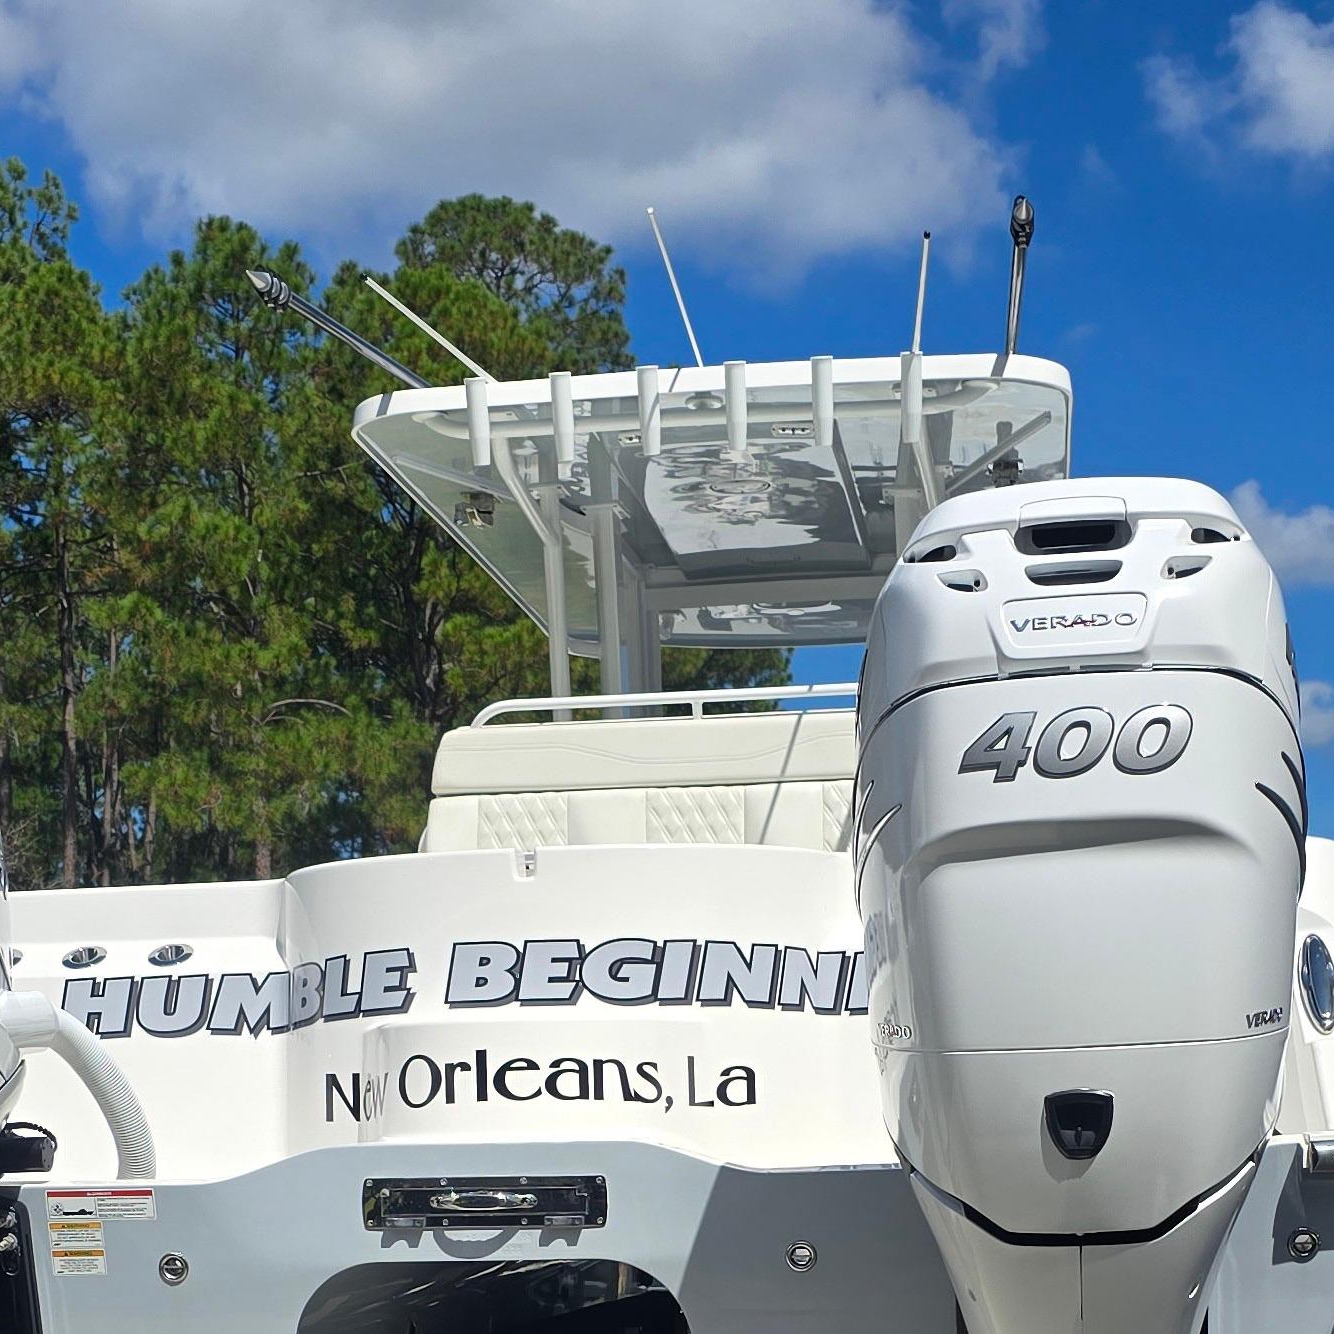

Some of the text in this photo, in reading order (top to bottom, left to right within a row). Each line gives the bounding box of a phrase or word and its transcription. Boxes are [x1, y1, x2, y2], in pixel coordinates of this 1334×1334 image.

[1010, 613, 1137, 633] VERADO
[957, 704, 1194, 783] 400
[61, 947, 417, 1040] HUMBLE
[325, 1049, 757, 1123] New Orleans, La
